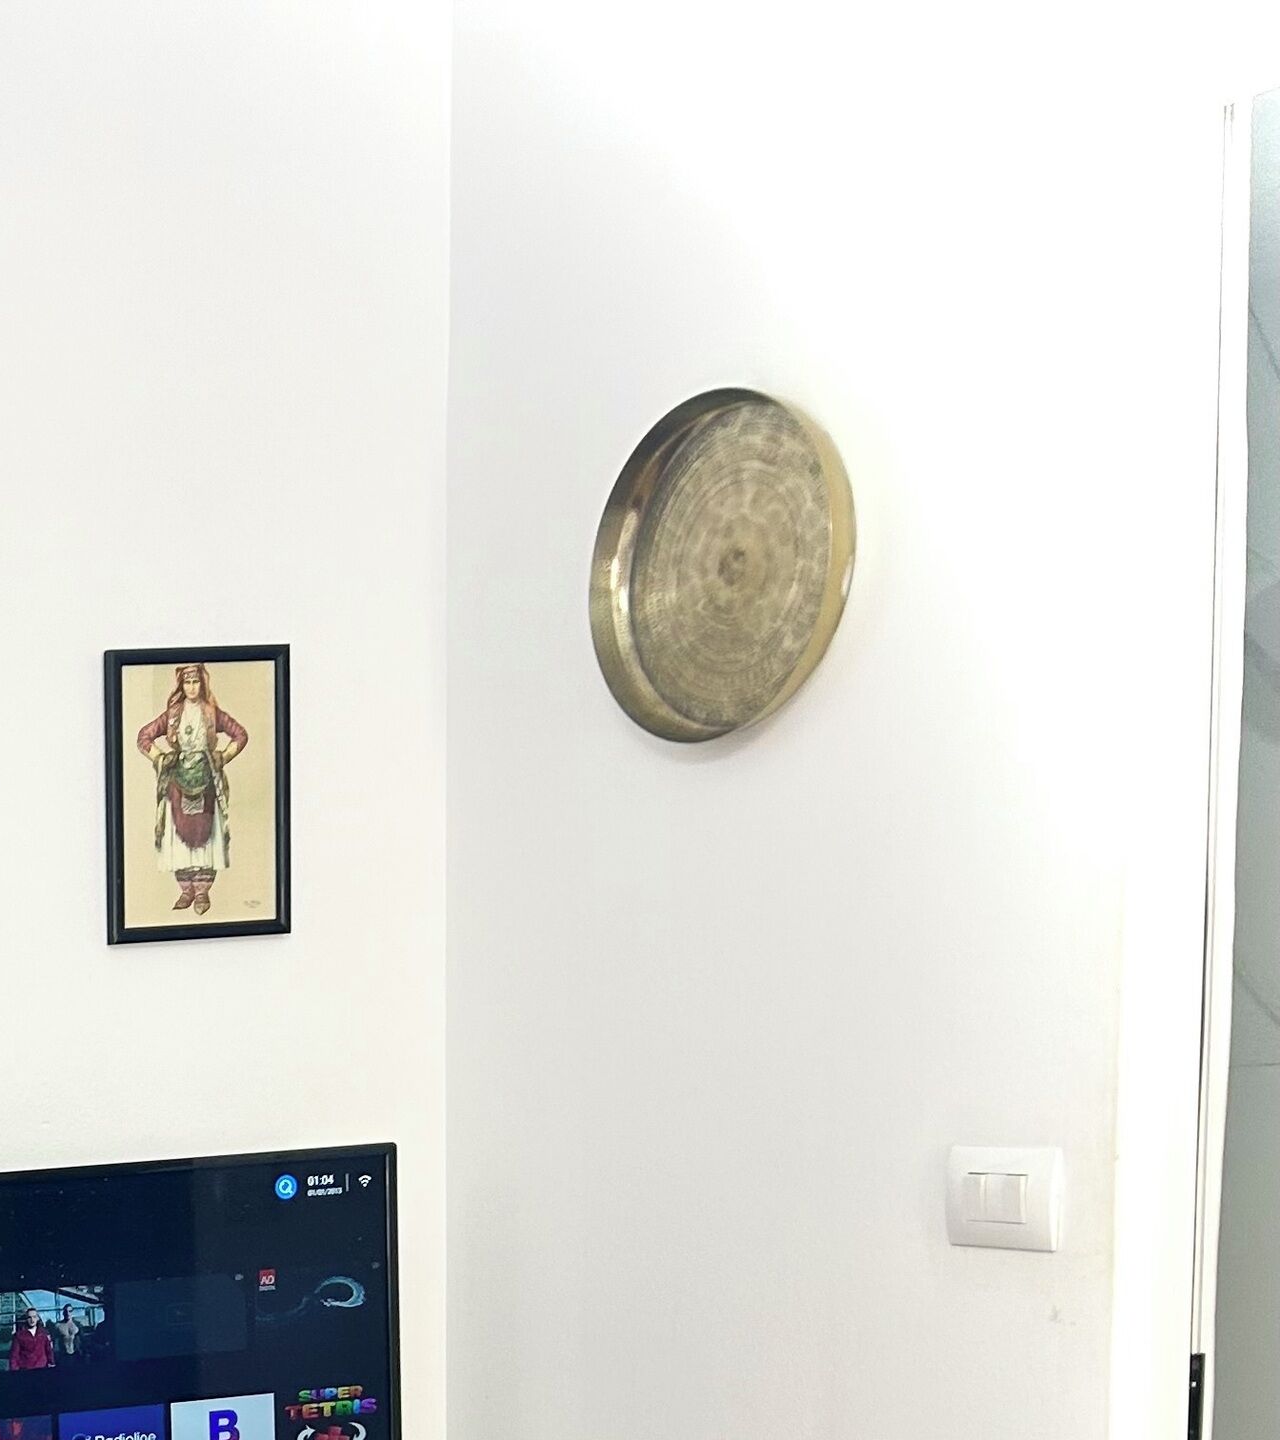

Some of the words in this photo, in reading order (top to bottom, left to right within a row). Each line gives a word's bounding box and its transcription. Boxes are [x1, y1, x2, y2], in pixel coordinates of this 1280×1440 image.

[306, 1174, 335, 1187] 01:04
[297, 1385, 364, 1402] SUPER
[284, 1397, 378, 1421] TETRIS
